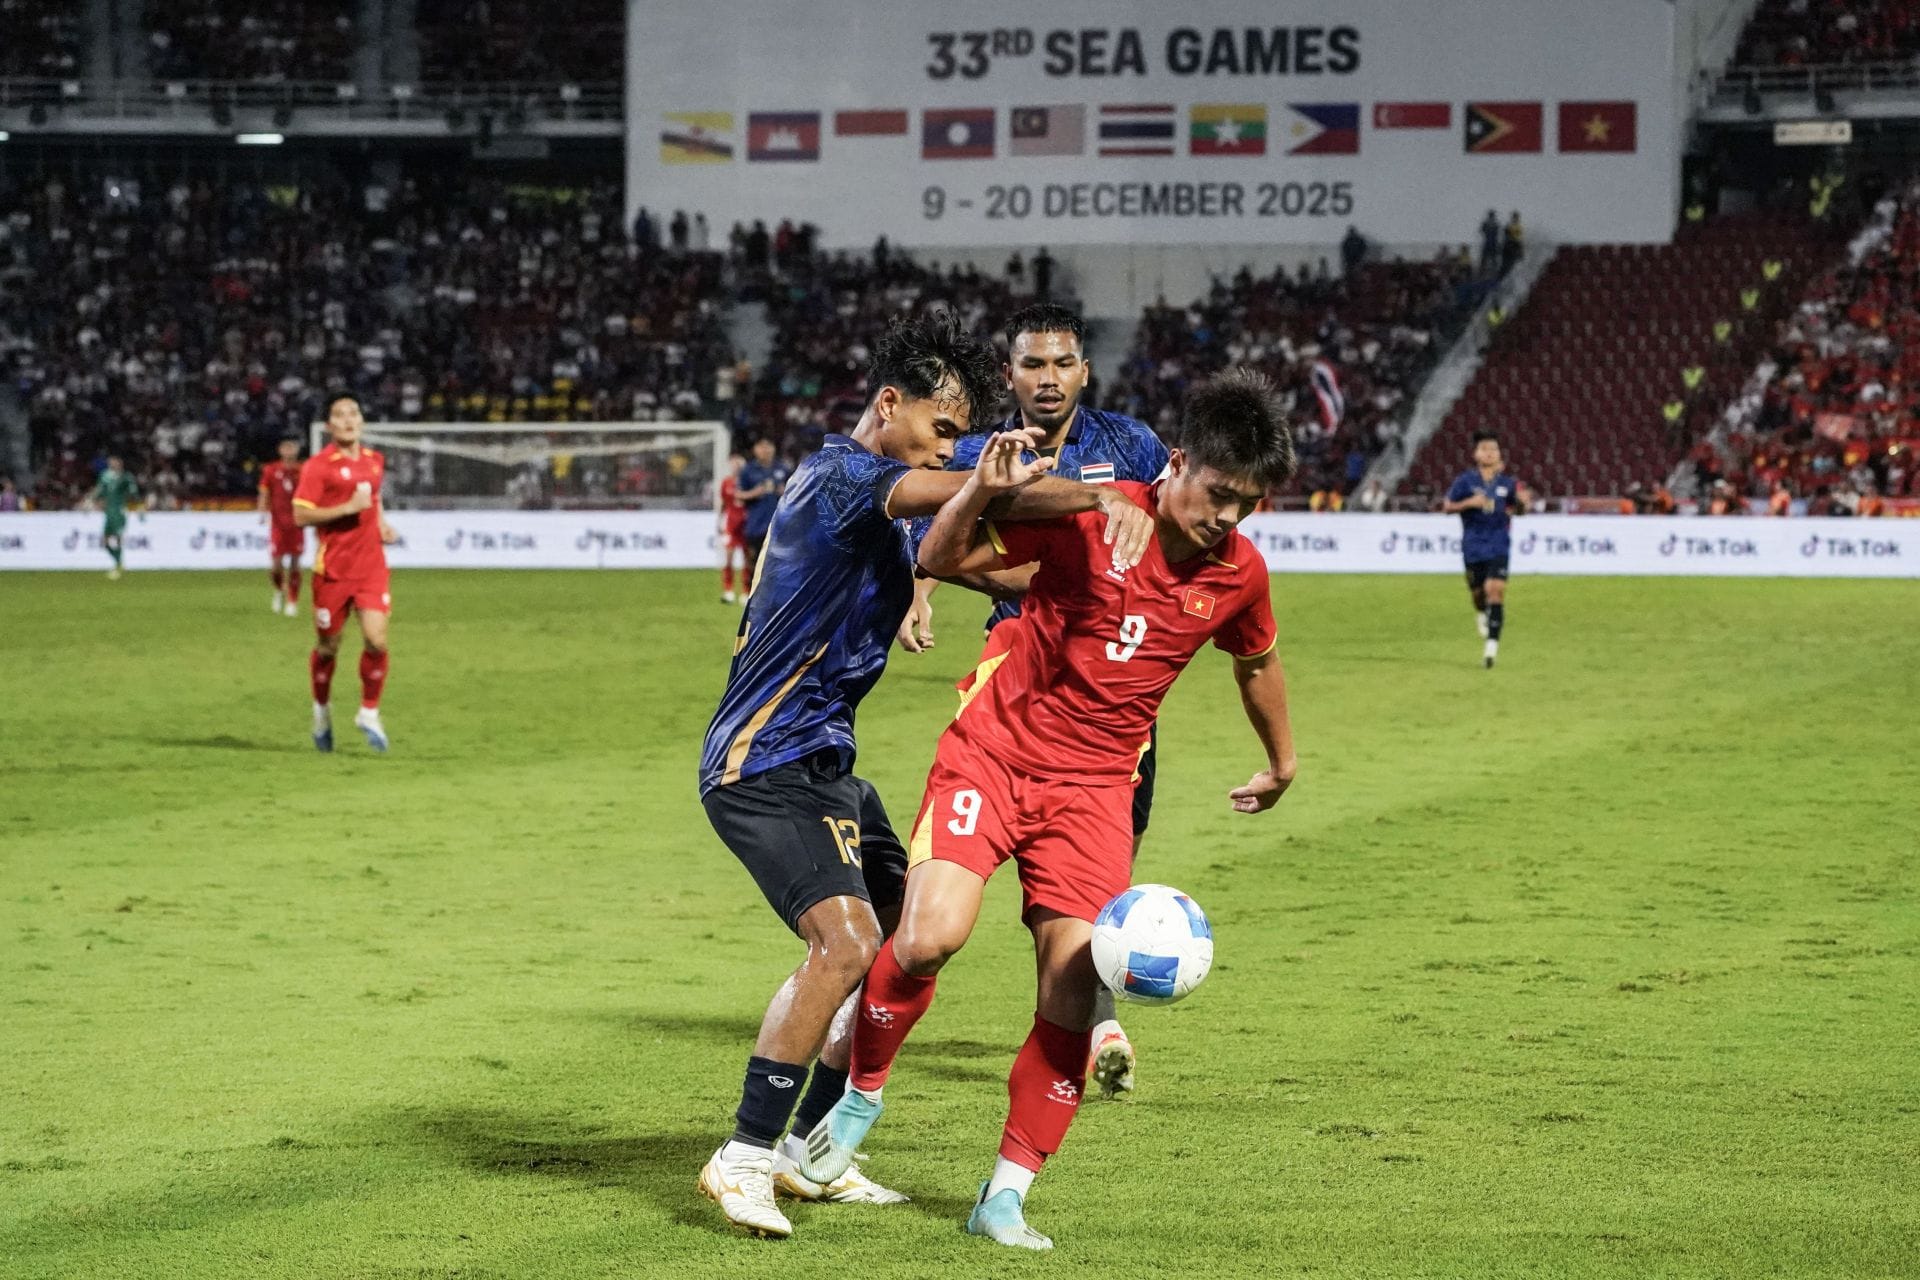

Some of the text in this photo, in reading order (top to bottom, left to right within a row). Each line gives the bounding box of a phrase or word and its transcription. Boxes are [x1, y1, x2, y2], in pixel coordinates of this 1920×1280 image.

[926, 26, 1361, 80] 33RD SEA GAMES
[922, 184, 946, 220] 9
[984, 183, 1031, 219] 20
[1043, 182, 1245, 217] DECEMBER
[1256, 181, 1355, 217] 2025
[1269, 534, 1339, 551] TikTok
[1406, 535, 1463, 554] TikTo
[1545, 536, 1617, 555] TikTok
[1685, 537, 1757, 556] TikTok
[1827, 538, 1901, 556] TikTok
[1105, 614, 1148, 662] 9
[947, 789, 983, 836] 9
[822, 816, 863, 869] 12
